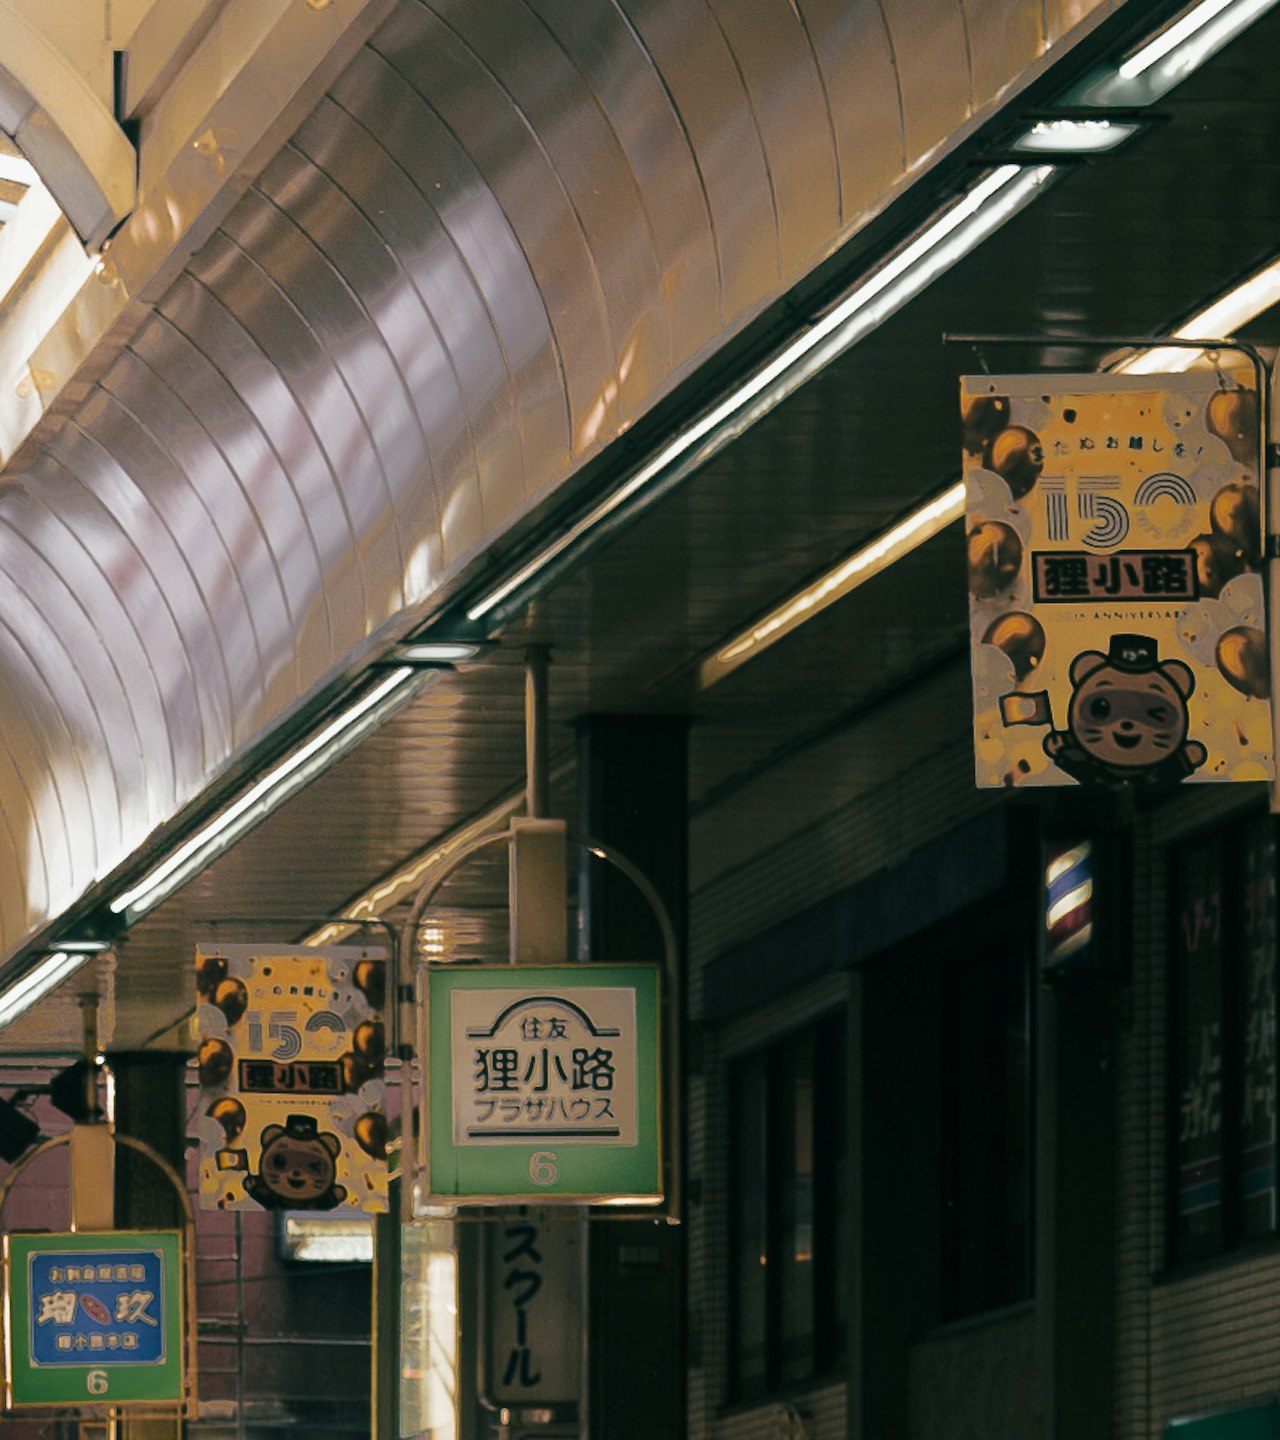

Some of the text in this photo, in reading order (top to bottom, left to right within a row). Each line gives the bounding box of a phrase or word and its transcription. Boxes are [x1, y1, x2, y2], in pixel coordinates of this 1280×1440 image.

[1040, 472, 1197, 548] 150
[1045, 557, 1187, 596] 狸小路
[521, 1015, 569, 1041] 住友
[474, 1046, 617, 1092] 狸小路
[528, 1151, 559, 1186] 6
[504, 1202, 541, 1387] スクール
[86, 1370, 109, 1395] 6
